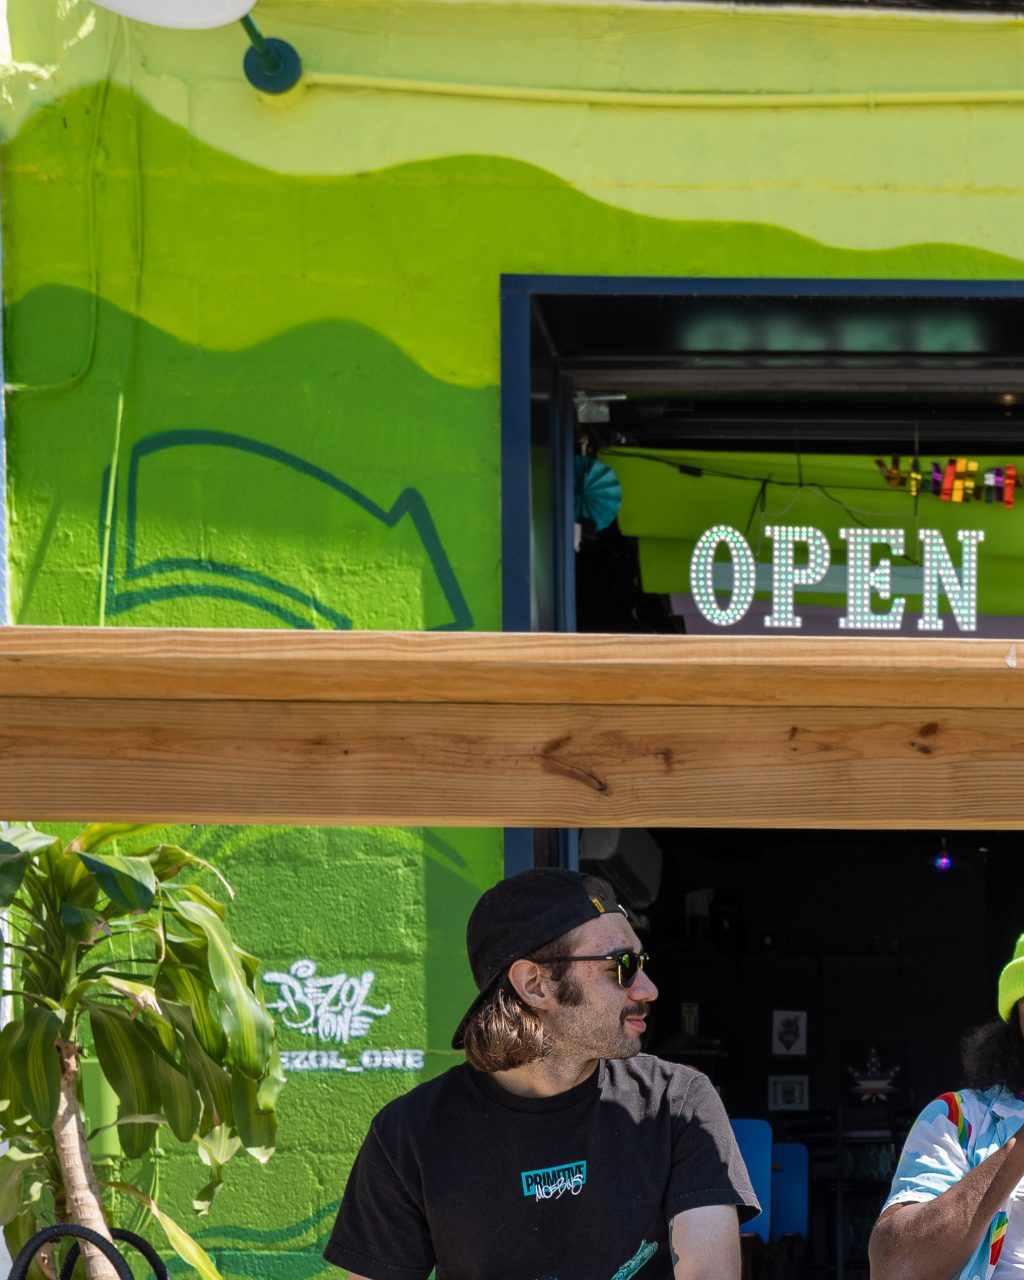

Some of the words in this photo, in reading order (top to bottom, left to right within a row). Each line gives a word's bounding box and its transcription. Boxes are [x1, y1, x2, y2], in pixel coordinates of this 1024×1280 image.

[690, 524, 985, 632] OPEN
[278, 1049, 425, 1072] EZOL_ONE
[525, 1164, 585, 1193] PRIMITIVE
